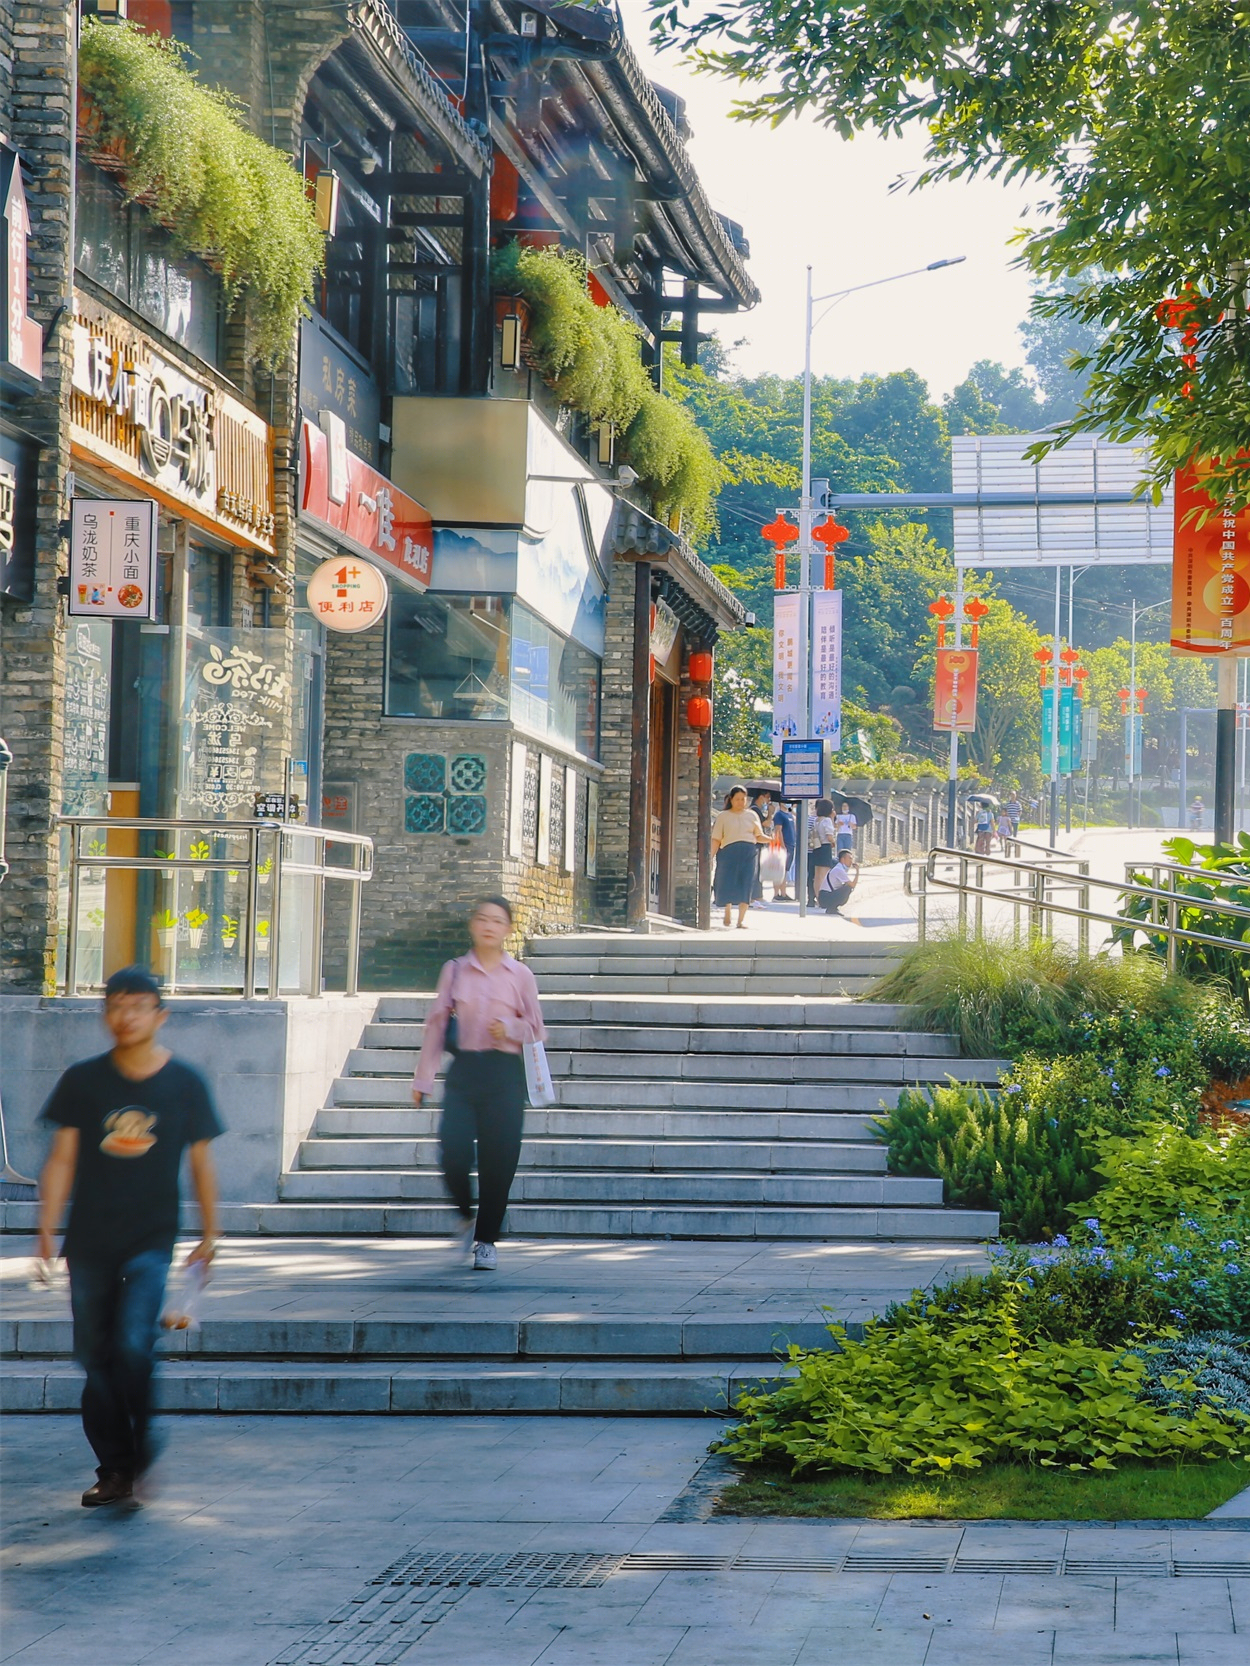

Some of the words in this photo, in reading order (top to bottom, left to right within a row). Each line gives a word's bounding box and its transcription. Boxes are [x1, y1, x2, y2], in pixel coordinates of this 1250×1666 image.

[322, 356, 357, 418] 私房菜
[82, 513, 98, 577] 乌泷奶茶
[124, 516, 140, 580] 重庆小面
[1220, 486, 1237, 649] 庆祝中国共产党成立一百周年
[317, 601, 375, 613] 便利店
